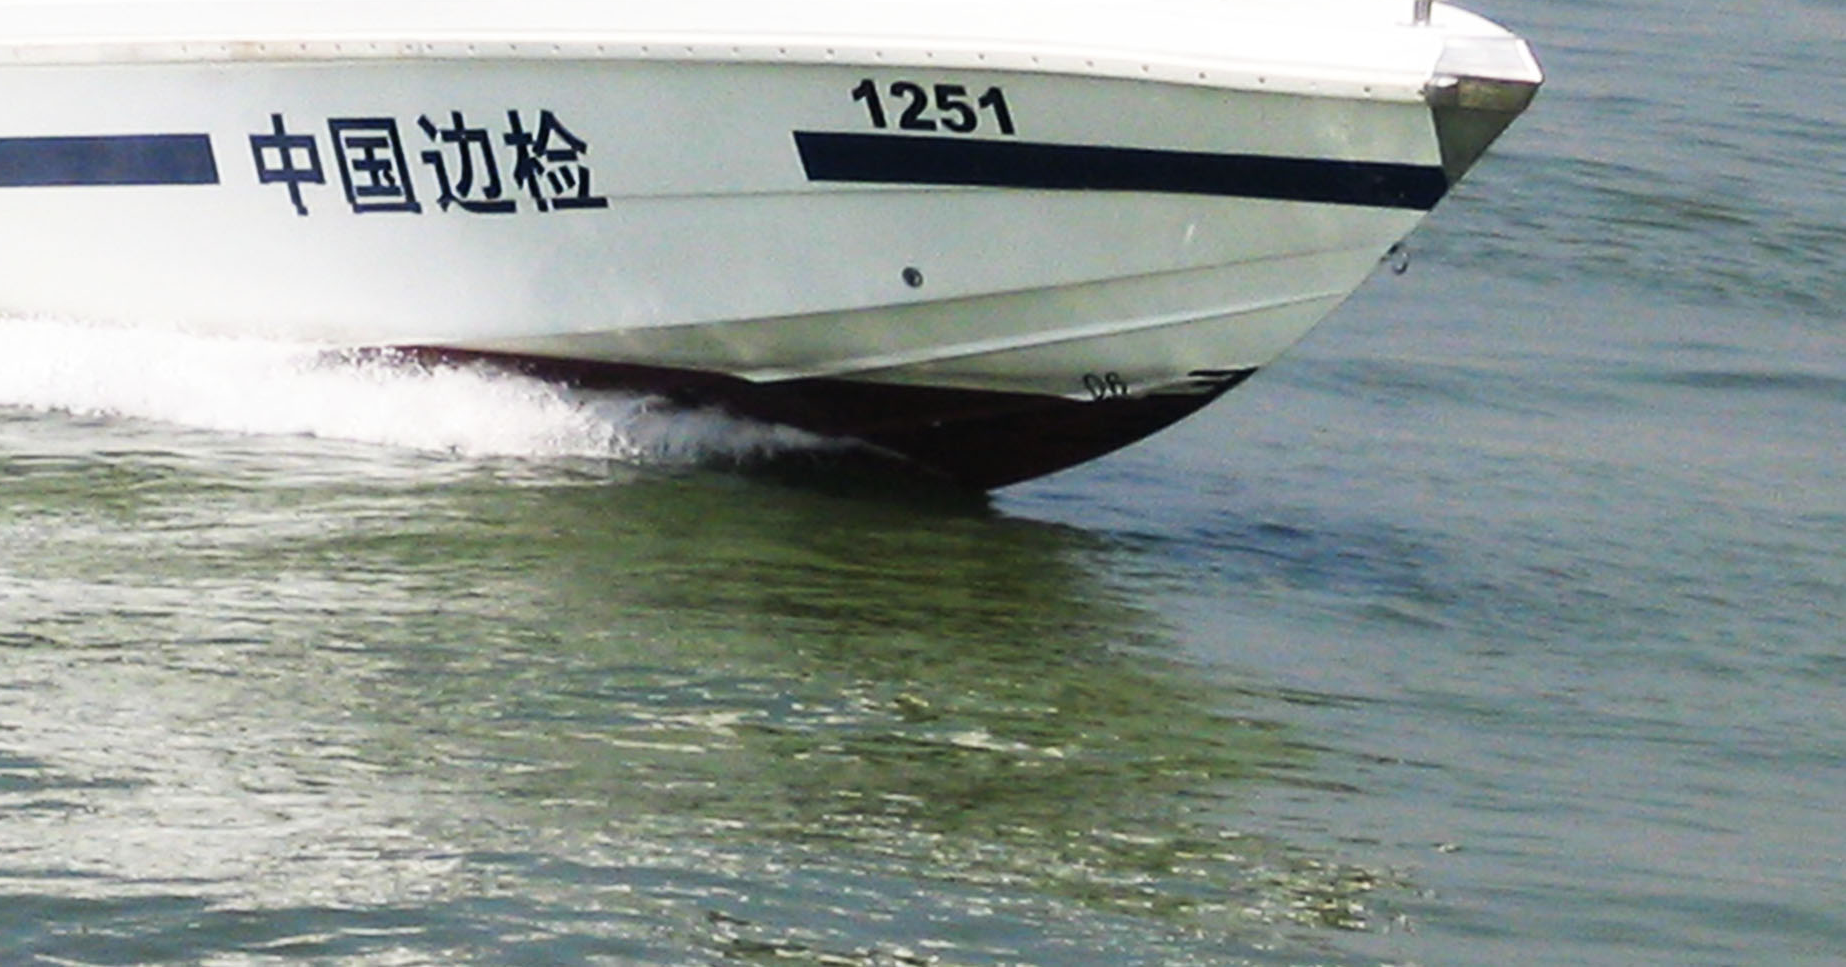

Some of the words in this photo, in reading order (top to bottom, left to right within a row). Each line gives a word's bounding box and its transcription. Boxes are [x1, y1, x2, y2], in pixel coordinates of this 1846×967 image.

[851, 78, 1015, 135] 1251
[249, 109, 609, 216] 中国边检
